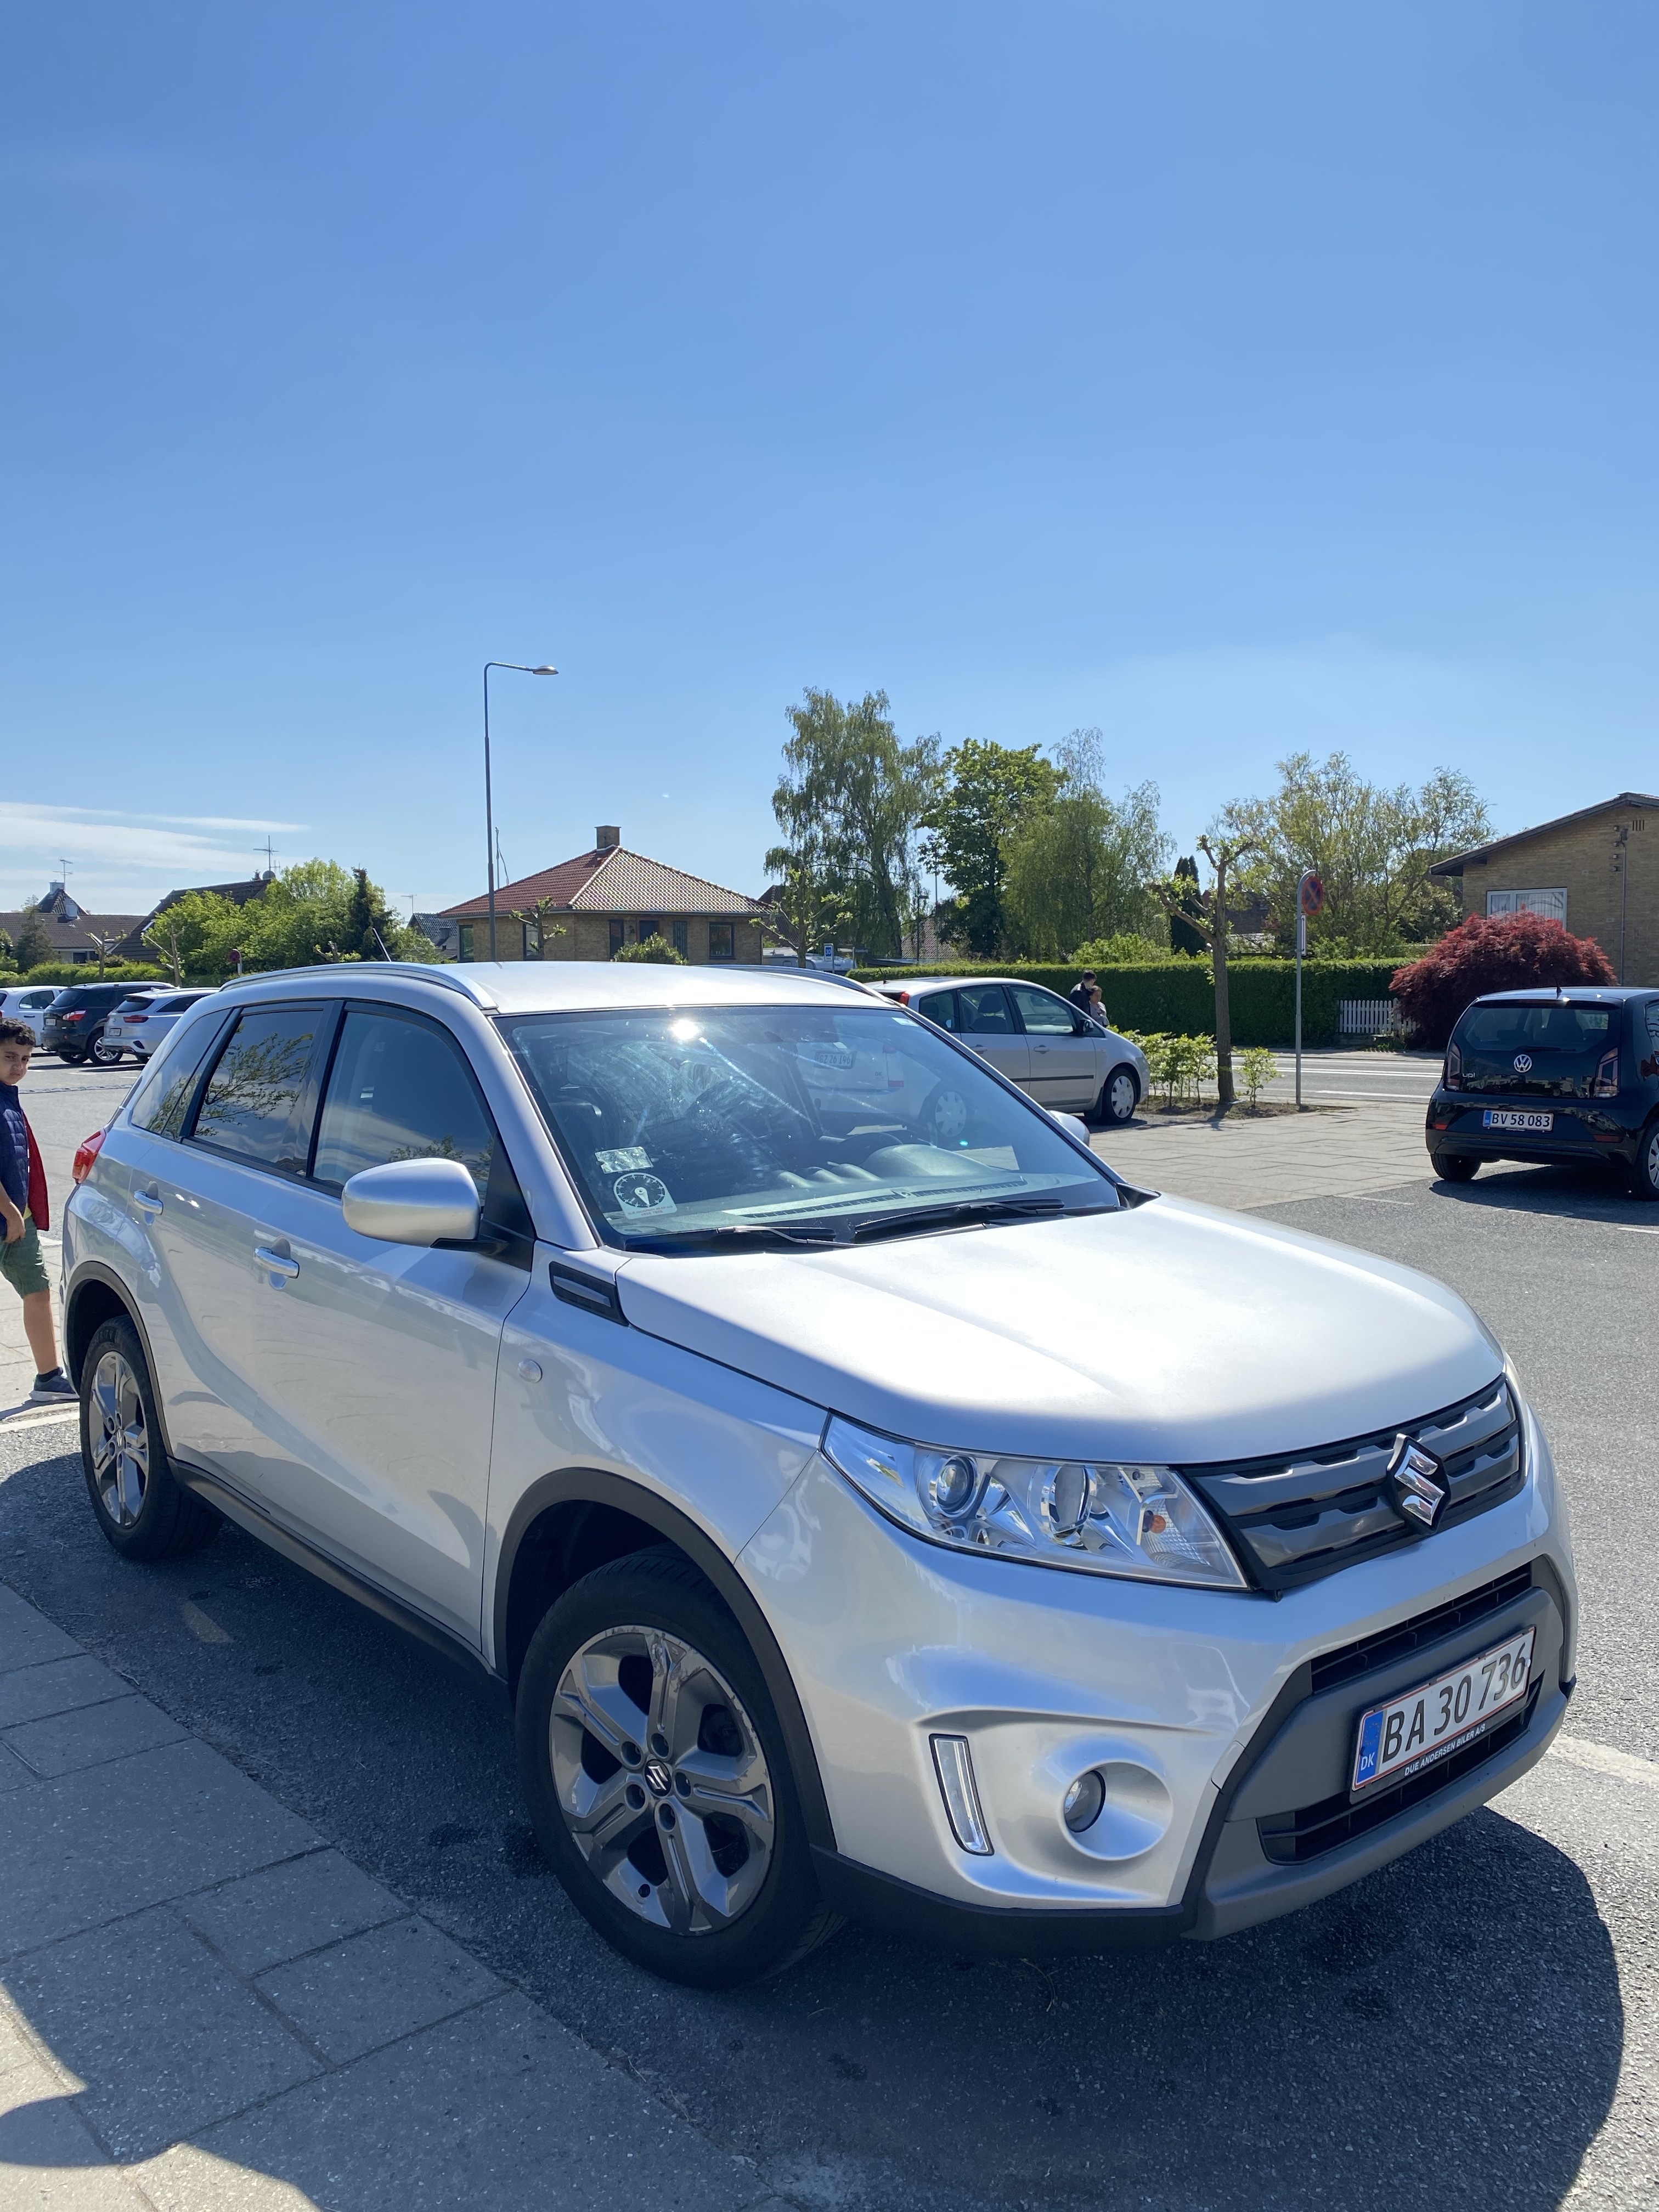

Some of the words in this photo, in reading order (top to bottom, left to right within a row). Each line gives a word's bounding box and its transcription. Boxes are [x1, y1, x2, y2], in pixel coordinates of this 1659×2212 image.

[829, 1055, 837, 1064] 26
[838, 1055, 850, 1064] 196
[1492, 1113, 1508, 1125] BV
[1510, 1114, 1525, 1126] 58
[1528, 1115, 1550, 1127] 083
[1382, 1699, 1425, 1764] BA
[1434, 1675, 1472, 1736] 30
[1478, 1642, 1527, 1711] 736
[1404, 1761, 1419, 1776] DUE
[1420, 1742, 1455, 1768] ANDERSEN
[1457, 1729, 1475, 1747] BILER
[1475, 1723, 1486, 1737] A/S
[1361, 1754, 1374, 1771] DK
